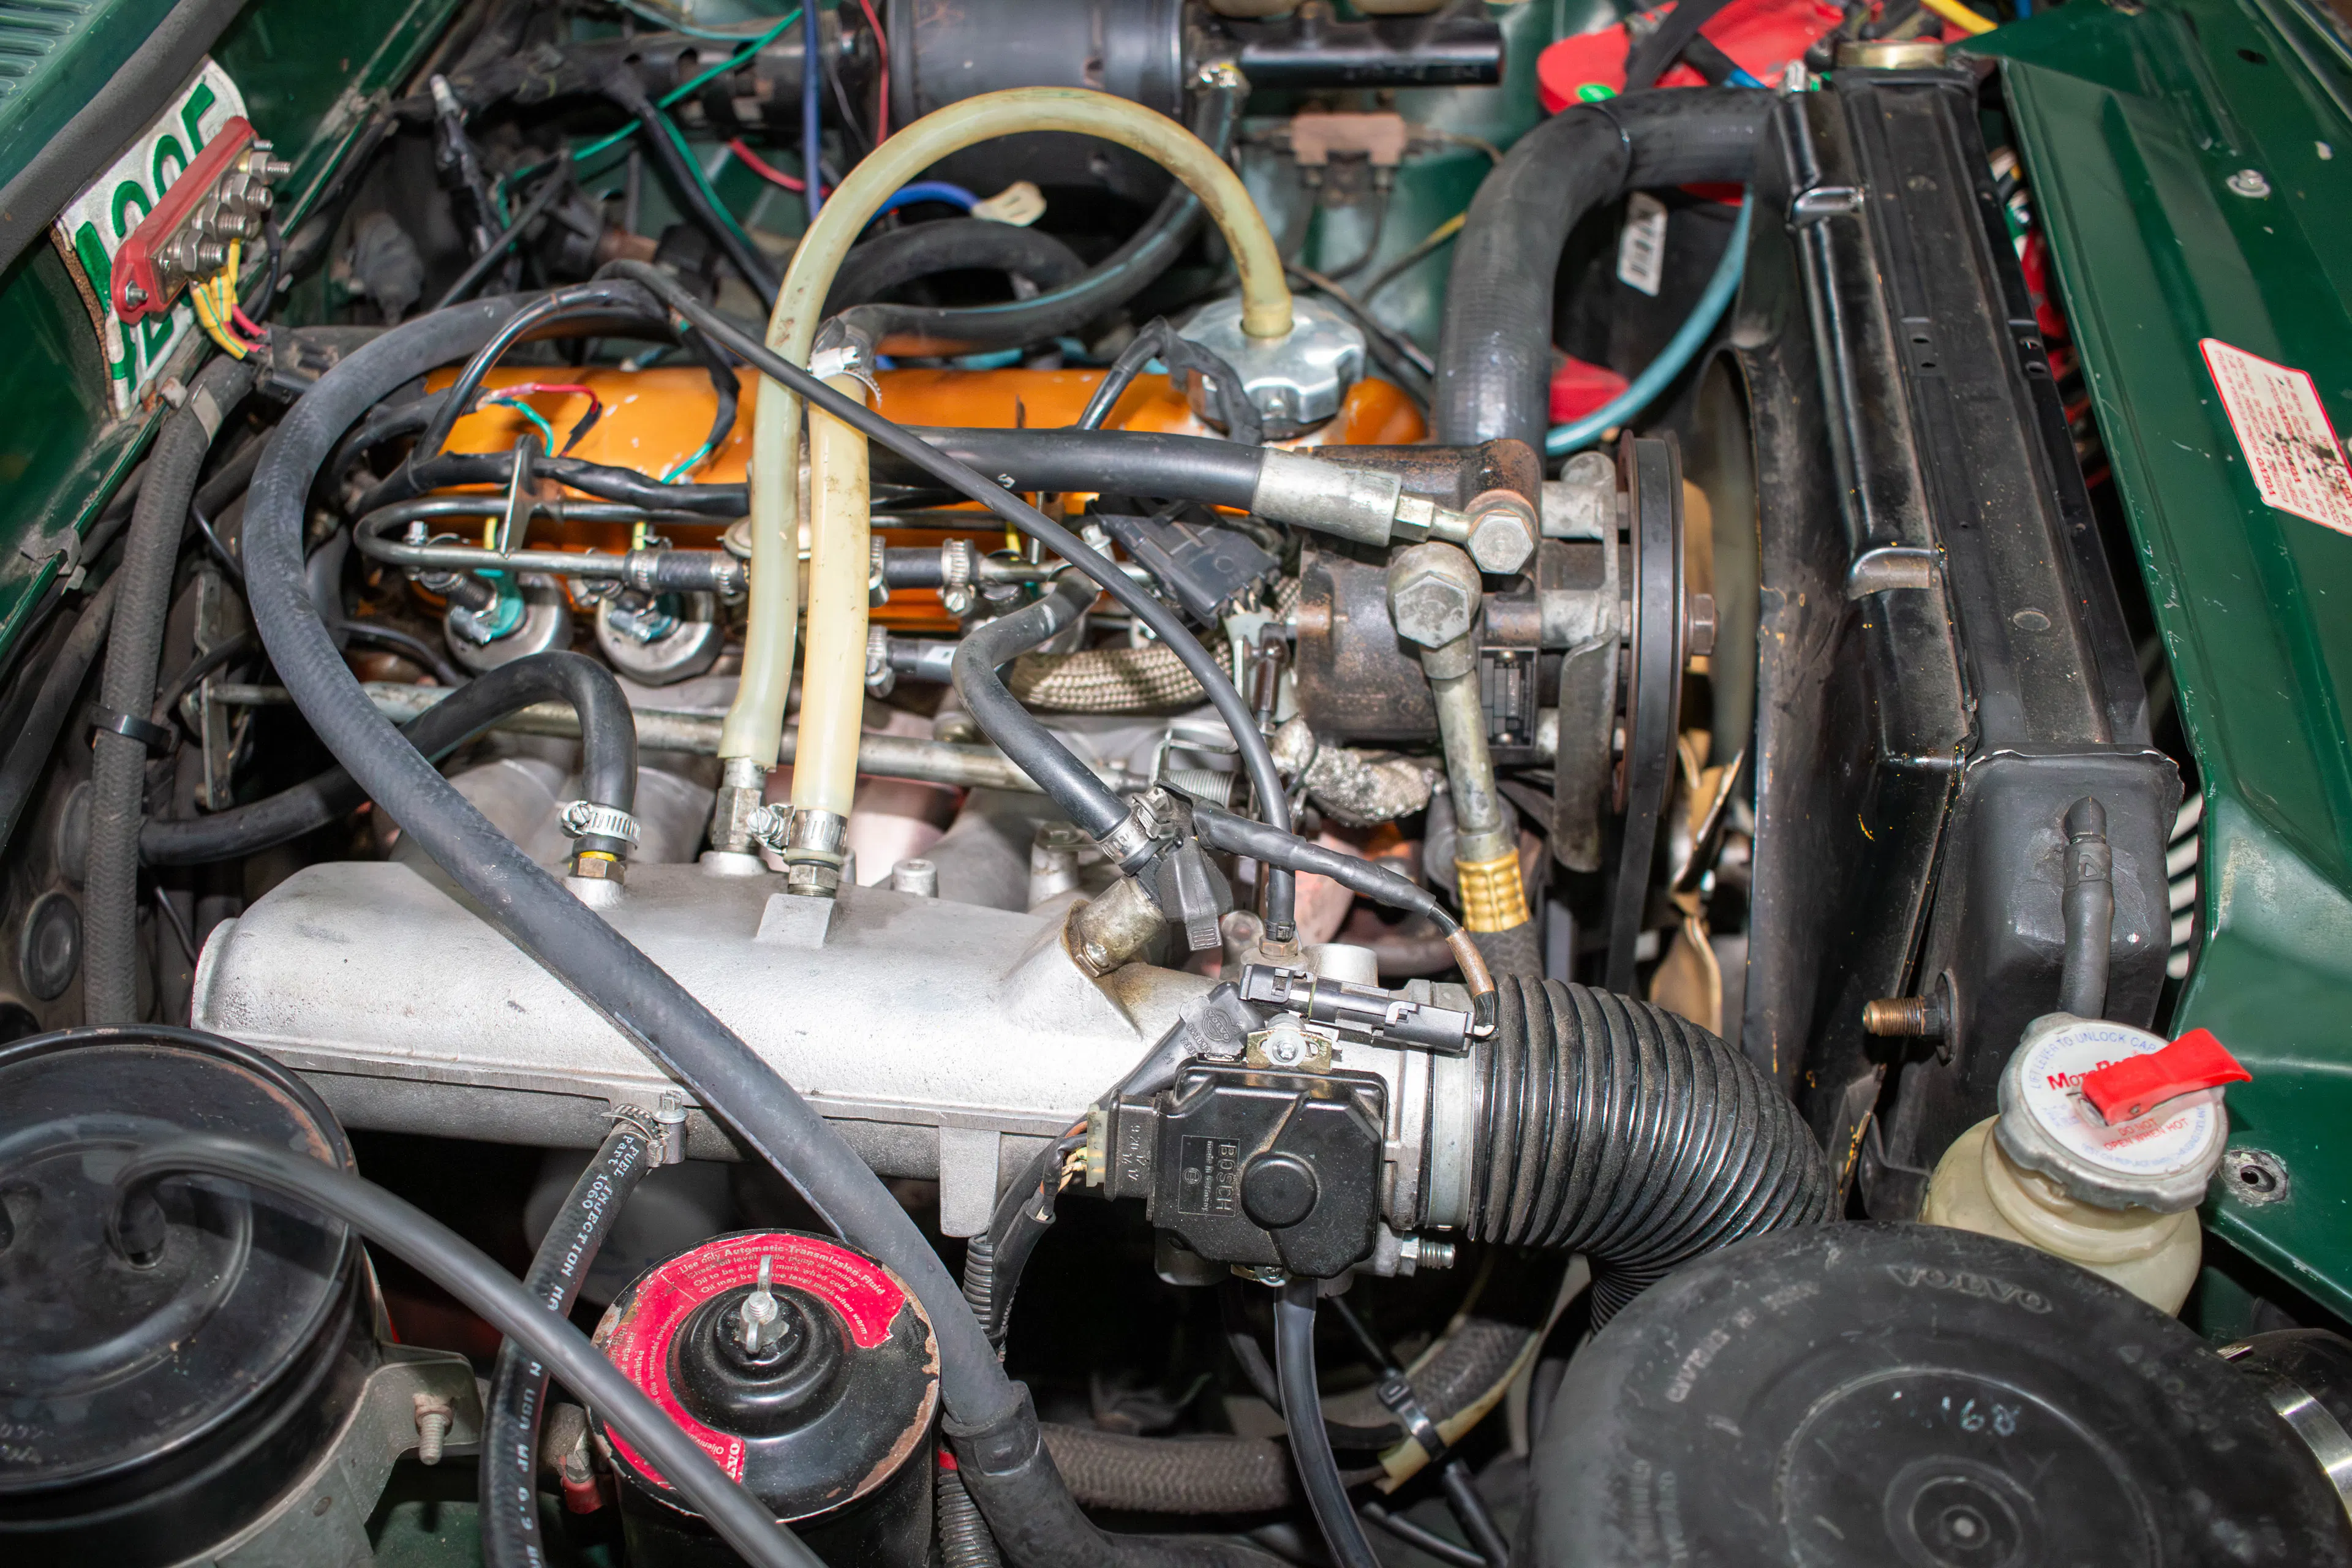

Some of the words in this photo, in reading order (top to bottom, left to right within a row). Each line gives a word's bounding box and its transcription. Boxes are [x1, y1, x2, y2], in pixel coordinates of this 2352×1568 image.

[2256, 457, 2276, 496] VOLVO
[2321, 490, 2341, 523] COOLING
[1207, 1010, 1229, 1040] VOLVO
[2075, 1031, 2128, 1044] UNLOCK
[2034, 1043, 2059, 1070] LEVER
[2056, 1036, 2074, 1047] TO
[2130, 1037, 2157, 1052] CAP
[2029, 1070, 2041, 1090] LIFT
[2103, 1137, 2133, 1151] OPEN
[2133, 1128, 2166, 1142] WHEN
[2165, 1118, 2190, 1131] HOT
[2117, 1126, 2135, 1137] DO
[2135, 1118, 2158, 1131] NOT
[608, 1135, 635, 1166] Part
[613, 1145, 639, 1177] FUEL
[582, 1174, 608, 1210] 1060
[1216, 1143, 1237, 1211] BOSCH
[560, 1185, 613, 1278] INJECTION
[679, 1262, 698, 1274] Use
[701, 1253, 721, 1264] only
[687, 1264, 717, 1280] Check
[733, 1254, 757, 1263] level
[788, 1256, 815, 1266] pump
[826, 1267, 858, 1287] running
[693, 1278, 707, 1287] Oil
[803, 1268, 827, 1281] when
[829, 1280, 850, 1293] cold
[701, 1285, 715, 1294] Oil
[717, 1276, 737, 1286] may
[789, 1273, 812, 1284] level
[813, 1281, 835, 1297] mark
[834, 1294, 854, 1313] when
[1886, 1264, 2053, 1314] VOLVO
[519, 1388, 536, 1430] USA
